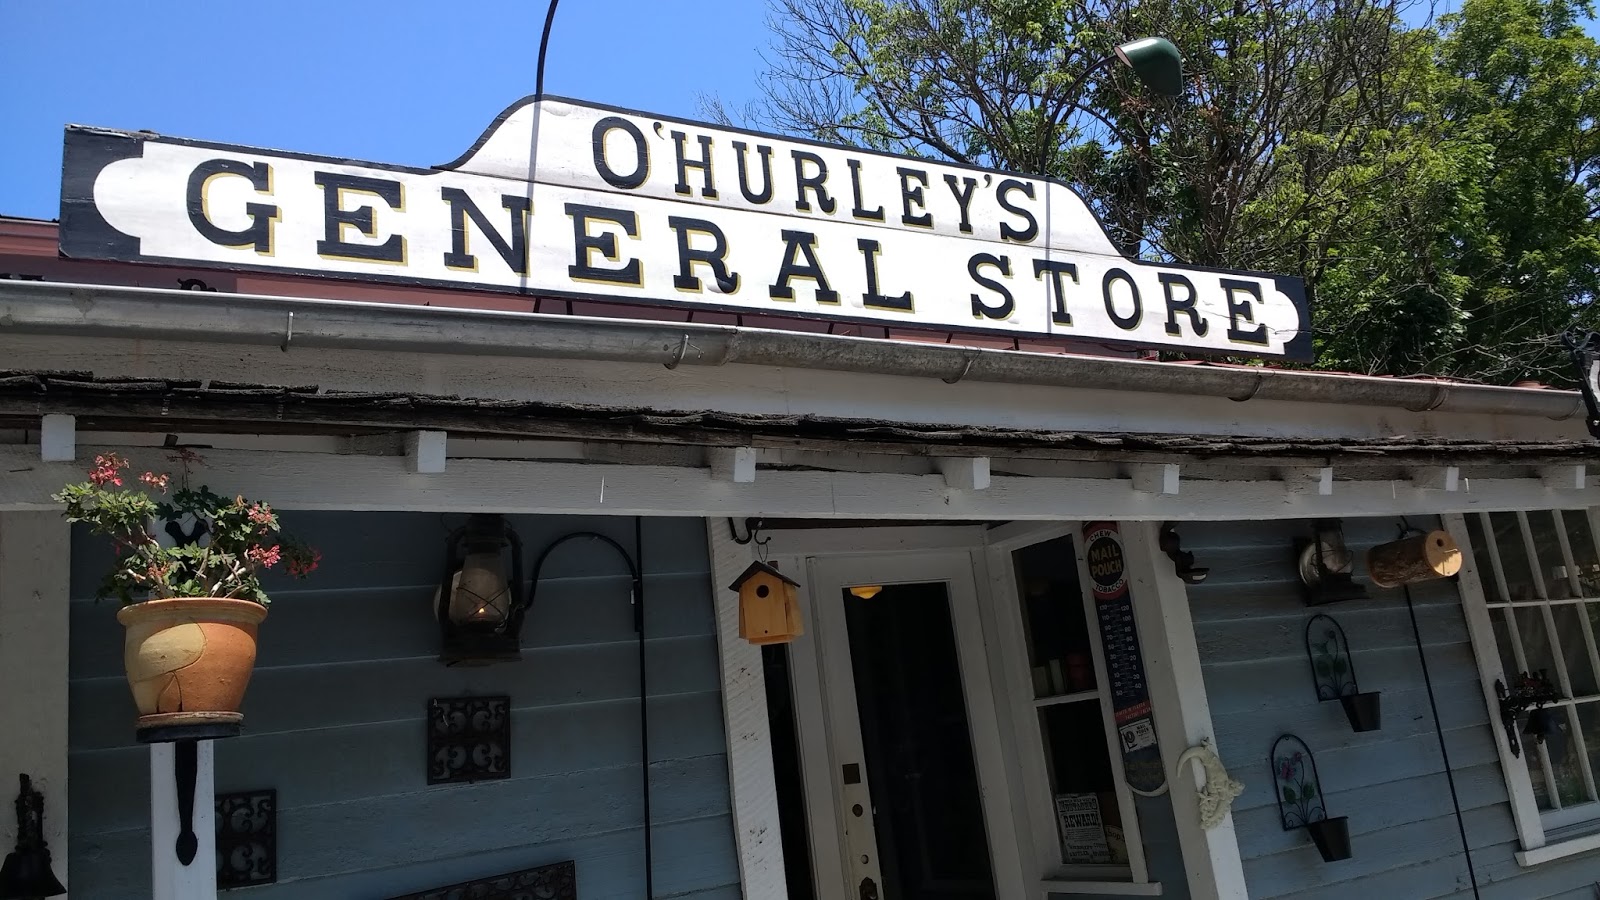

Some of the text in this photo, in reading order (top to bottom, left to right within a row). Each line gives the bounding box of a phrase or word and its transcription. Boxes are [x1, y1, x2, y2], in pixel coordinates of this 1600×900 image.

[592, 116, 1039, 244] O'HURLEY'S
[186, 158, 1270, 346] GENERAL STORE
[1090, 530, 1111, 542] CHEW
[1091, 544, 1119, 562] MAIL
[1091, 559, 1122, 578] POUCH
[1095, 579, 1123, 592] TOBACCO
